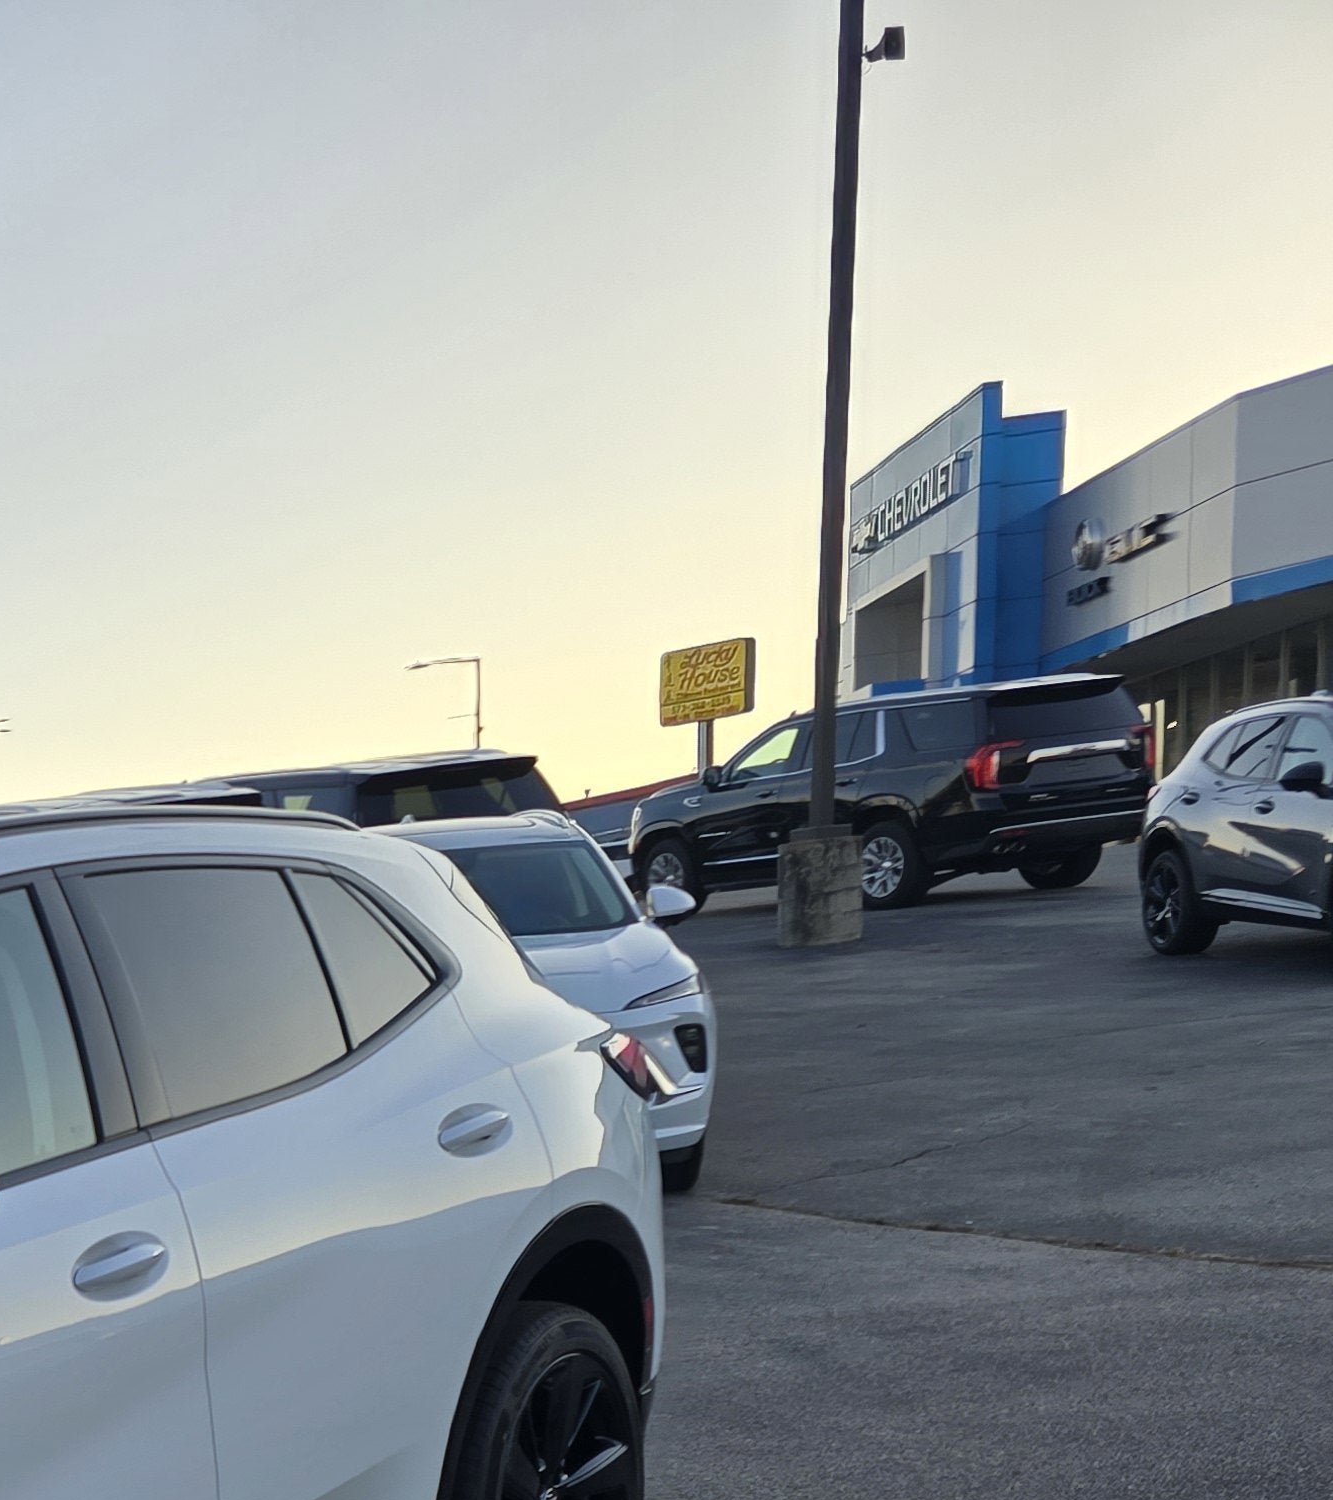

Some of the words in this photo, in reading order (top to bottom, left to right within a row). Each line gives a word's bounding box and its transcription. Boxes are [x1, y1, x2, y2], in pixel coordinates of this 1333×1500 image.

[877, 453, 958, 542] CHEVROLET
[680, 644, 739, 670] Lucky
[678, 666, 741, 692] House
